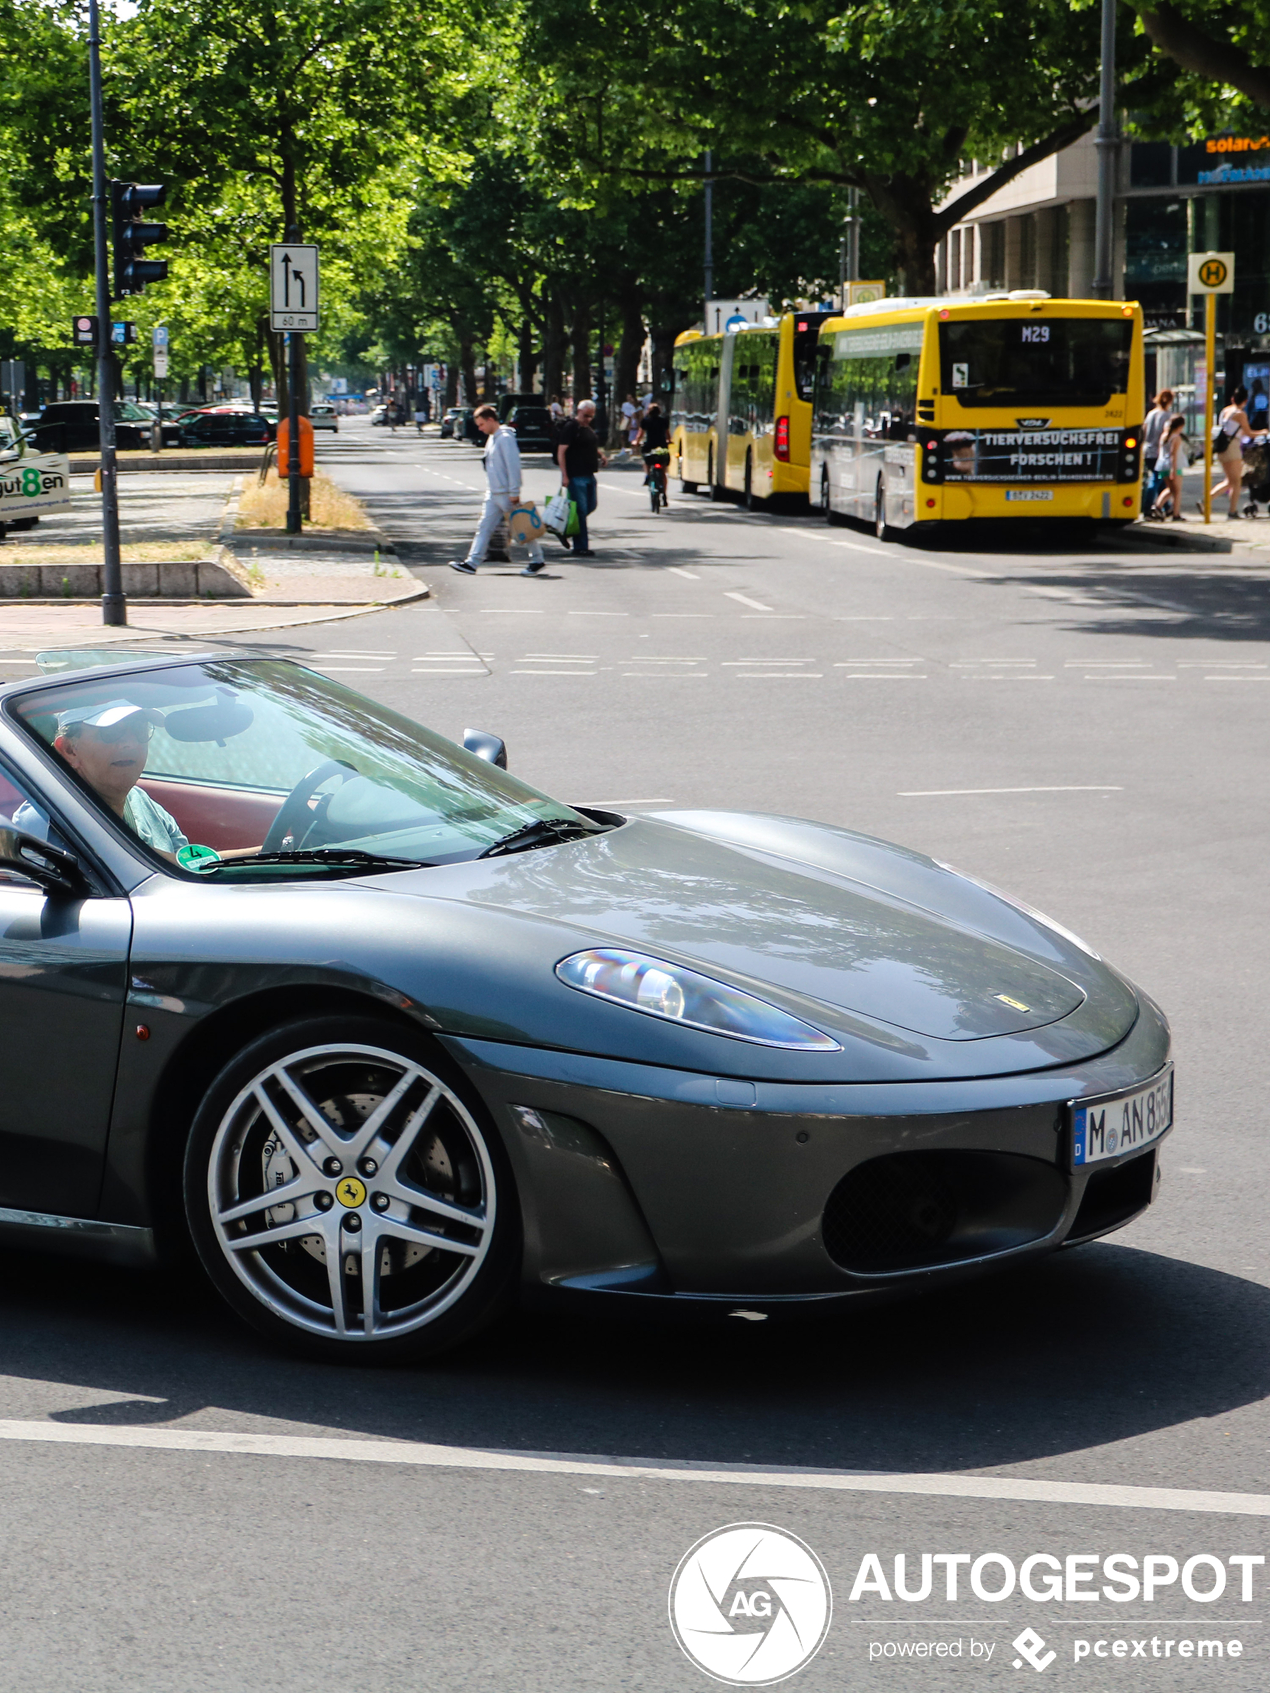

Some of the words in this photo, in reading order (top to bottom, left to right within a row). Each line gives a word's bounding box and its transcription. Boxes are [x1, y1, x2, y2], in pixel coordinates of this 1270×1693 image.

[1206, 266, 1220, 280] H
[282, 316, 294, 327] 60
[298, 318, 308, 327] m
[1254, 312, 1270, 334] 6
[156, 329, 165, 343] P
[1021, 326, 1050, 343] M29
[984, 432, 1119, 446] TIERVERSUCHSFREI
[1010, 453, 1082, 466] FORSCHEN
[189, 846, 202, 858] 4
[1089, 1109, 1106, 1157] M
[1121, 1096, 1144, 1147] AN
[1074, 1144, 1081, 1157] D
